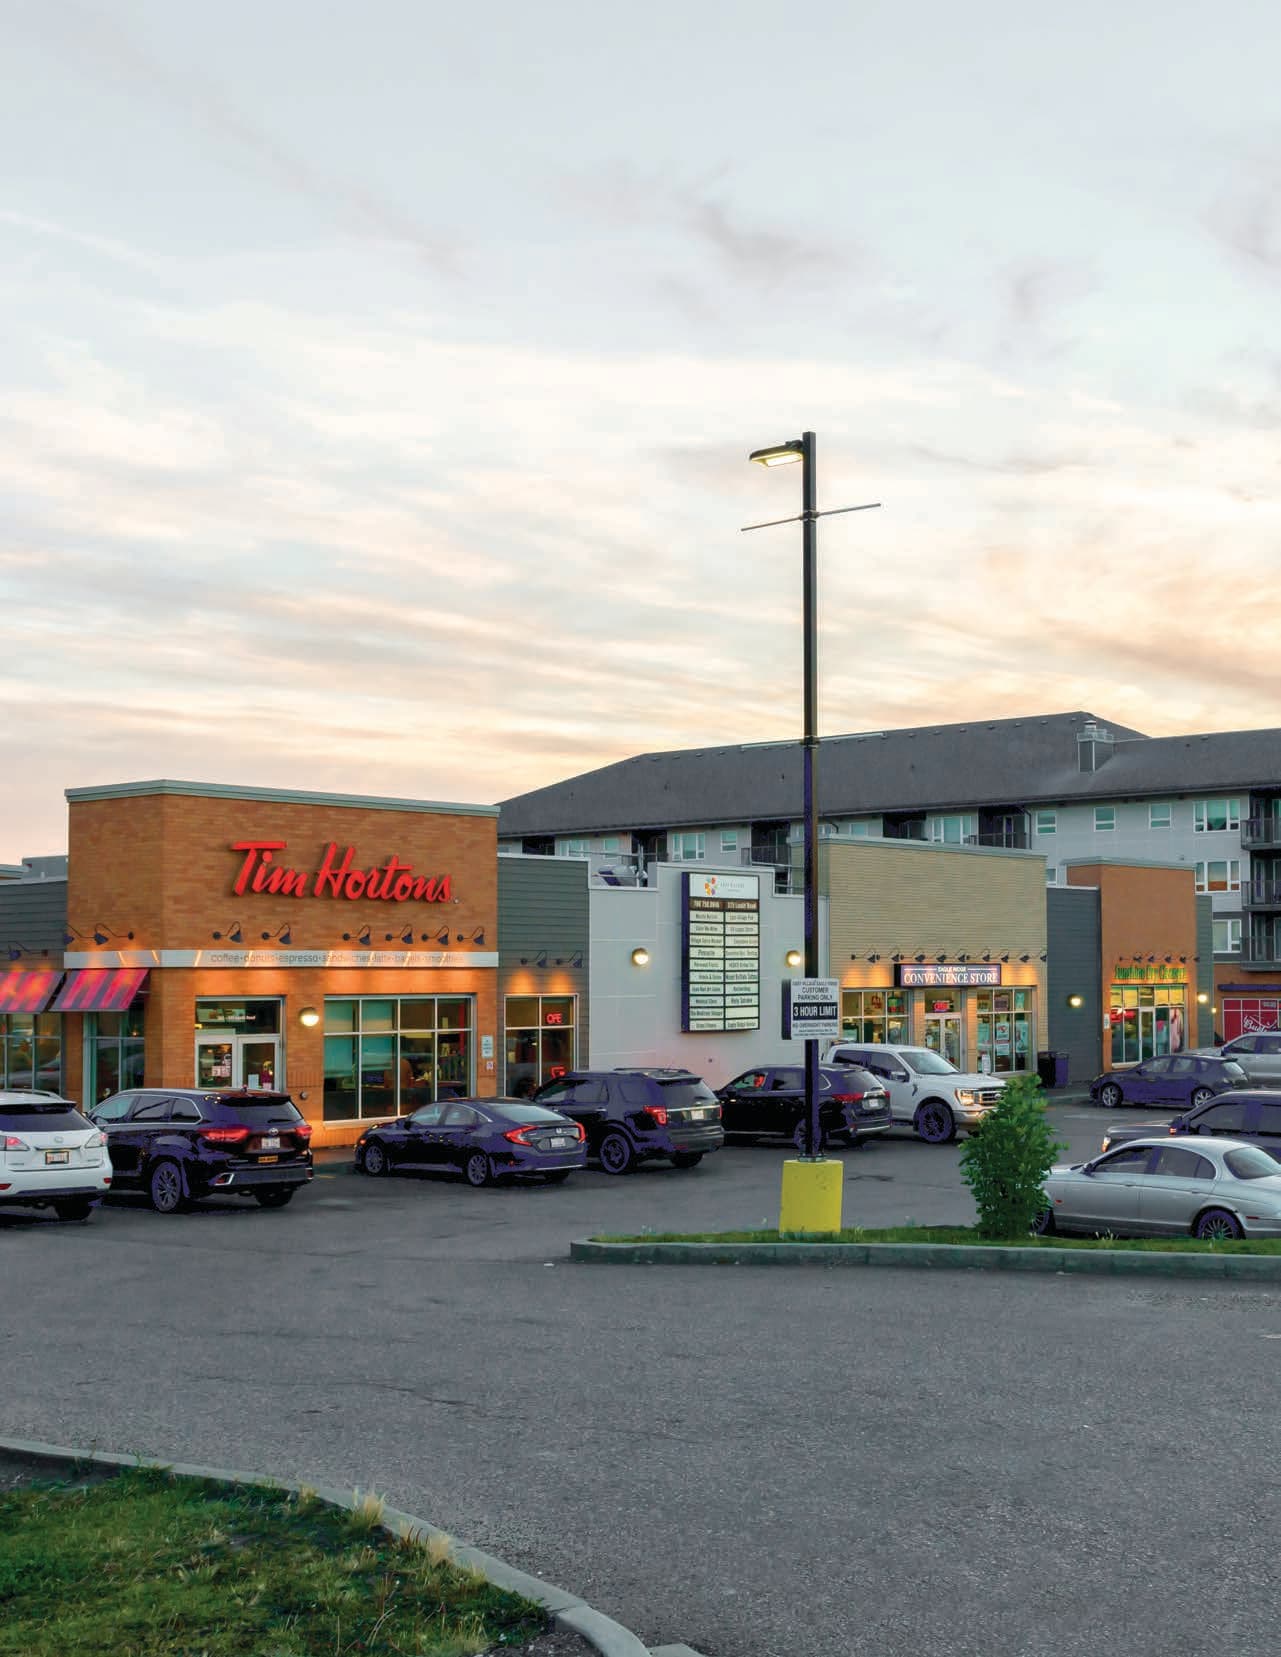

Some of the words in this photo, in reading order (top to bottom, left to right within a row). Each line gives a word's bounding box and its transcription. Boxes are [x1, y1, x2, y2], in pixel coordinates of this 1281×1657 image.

[232, 841, 308, 897] Tim
[314, 842, 453, 903] Hortons
[210, 953, 240, 962] coffee
[279, 953, 318, 965] espresso
[904, 973, 969, 984] CONVENIENCE
[970, 972, 998, 983] STORE
[802, 986, 829, 994] CUSTOMER
[793, 1006, 799, 1017] 3
[799, 1006, 818, 1017] HOUR
[819, 1005, 837, 1016] LIMIT
